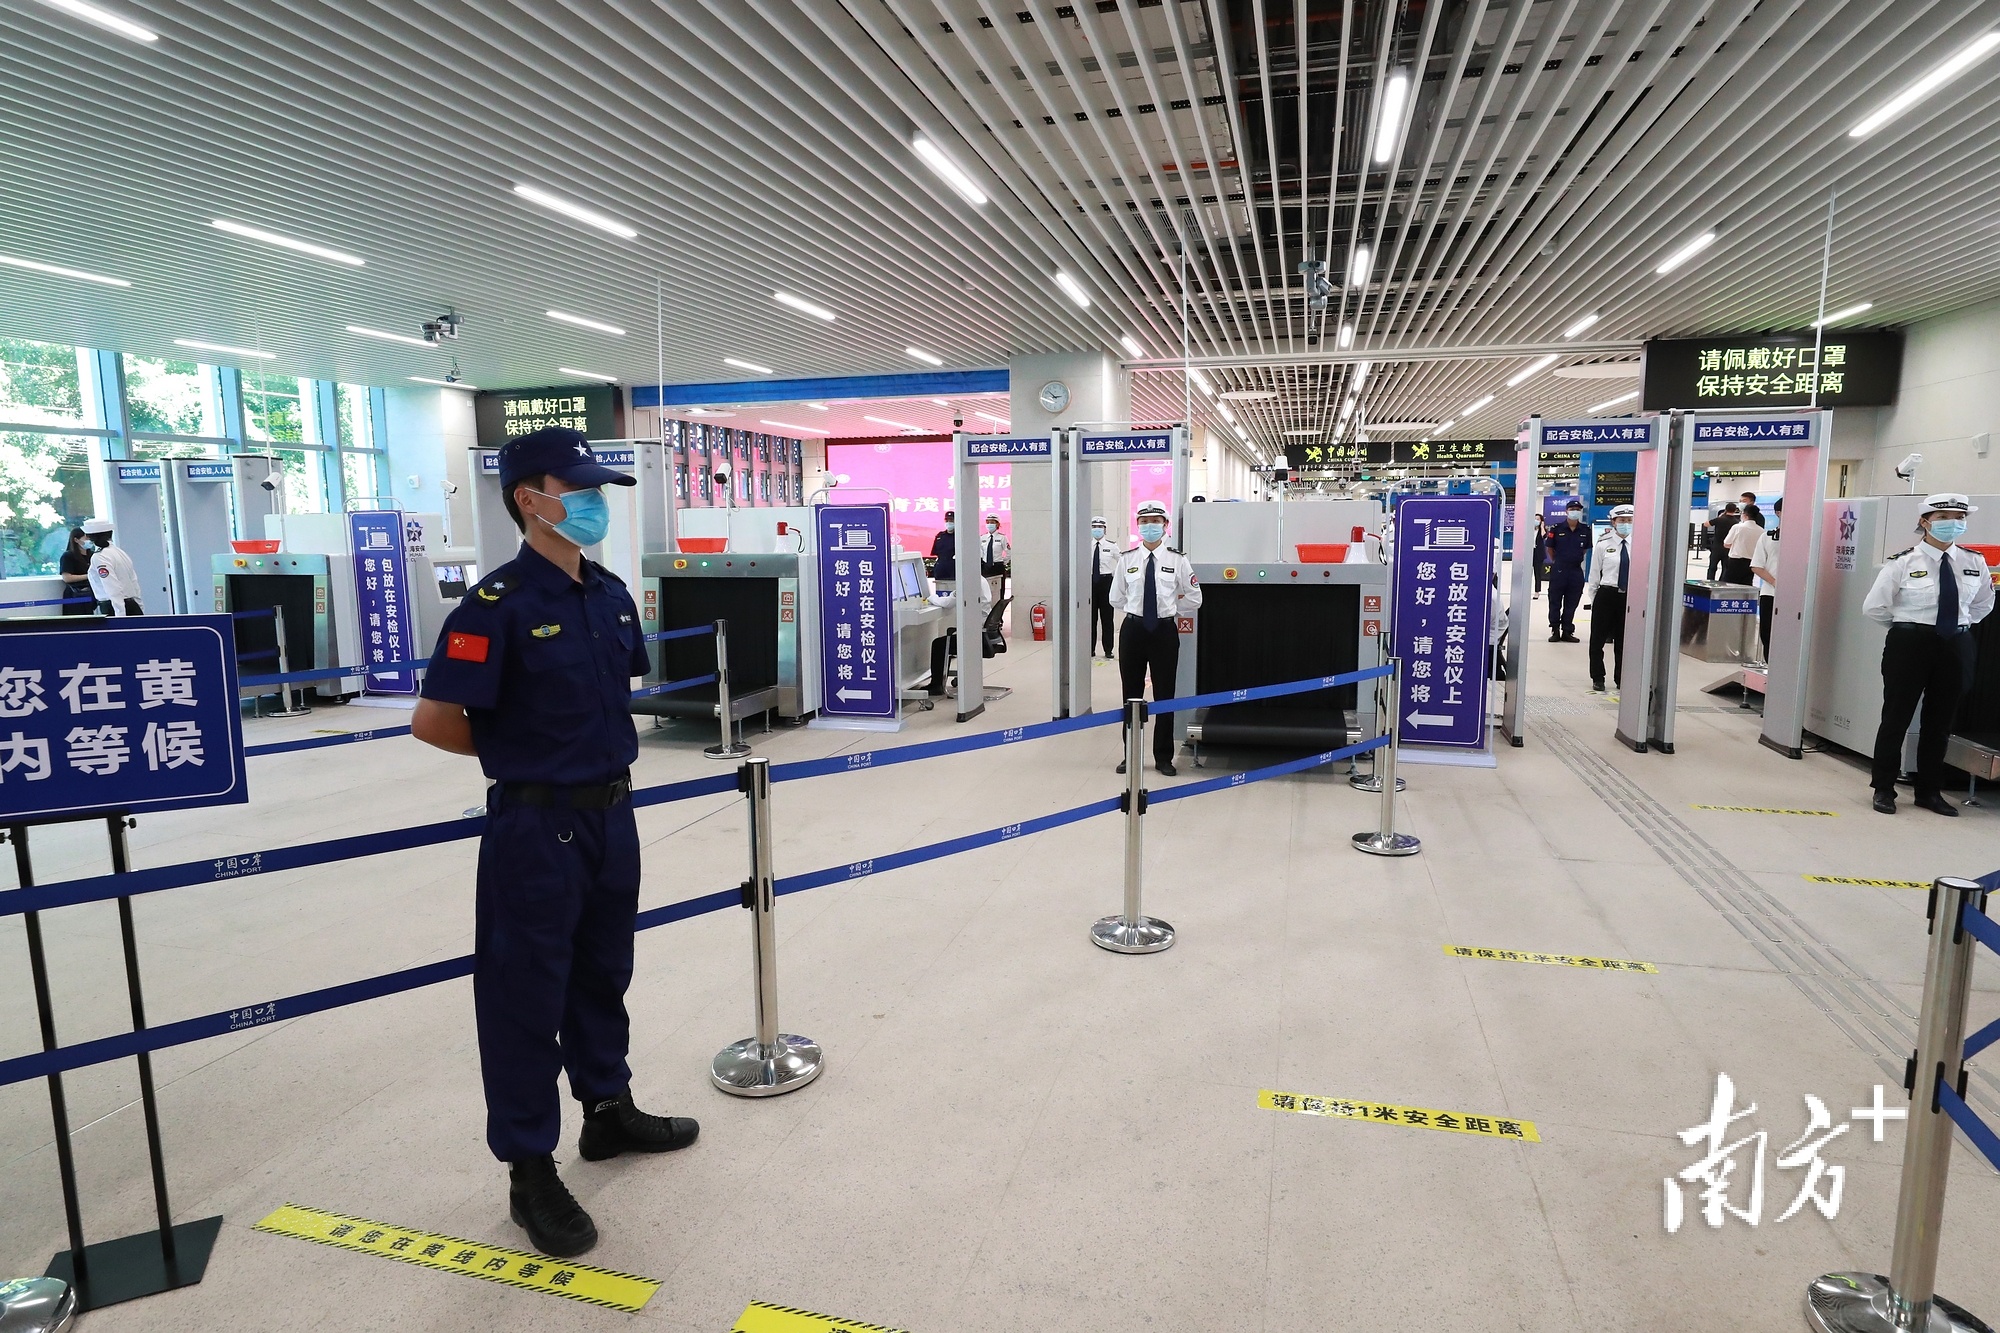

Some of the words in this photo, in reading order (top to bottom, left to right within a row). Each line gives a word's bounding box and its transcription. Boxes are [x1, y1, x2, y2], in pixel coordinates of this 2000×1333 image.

[1698, 345, 1847, 372] 请佩戴好口罩
[1696, 371, 1845, 397] 保持安全距离
[503, 396, 587, 417] 请佩戴好口罩
[1546, 428, 1646, 441] 配合安检,人人有责
[1699, 425, 1805, 439] 配合安检,人人有责
[971, 441, 1048, 454] 配合安检,人人有责
[1085, 438, 1167, 452] 配合安检,人人有责
[1436, 442, 1485, 453] 卫生检疫
[381, 557, 402, 664] 包放在安检仪上
[1720, 600, 1750, 609] 安检台
[858, 559, 877, 681] 包放在安检仪上
[1442, 561, 1469, 706] 包放在安检仪上
[0, 658, 198, 718] 您在黄
[0, 721, 205, 784] 内等候
[214, 853, 262, 872] 中国口岸
[214, 869, 239, 879] CHINA
[241, 866, 262, 875] PORT
[229, 1002, 276, 1024] 中国口岸
[230, 1020, 254, 1030] CHINA
[255, 1014, 276, 1024] PORT
[328, 1222, 577, 1287] 请您在黄线内等候
